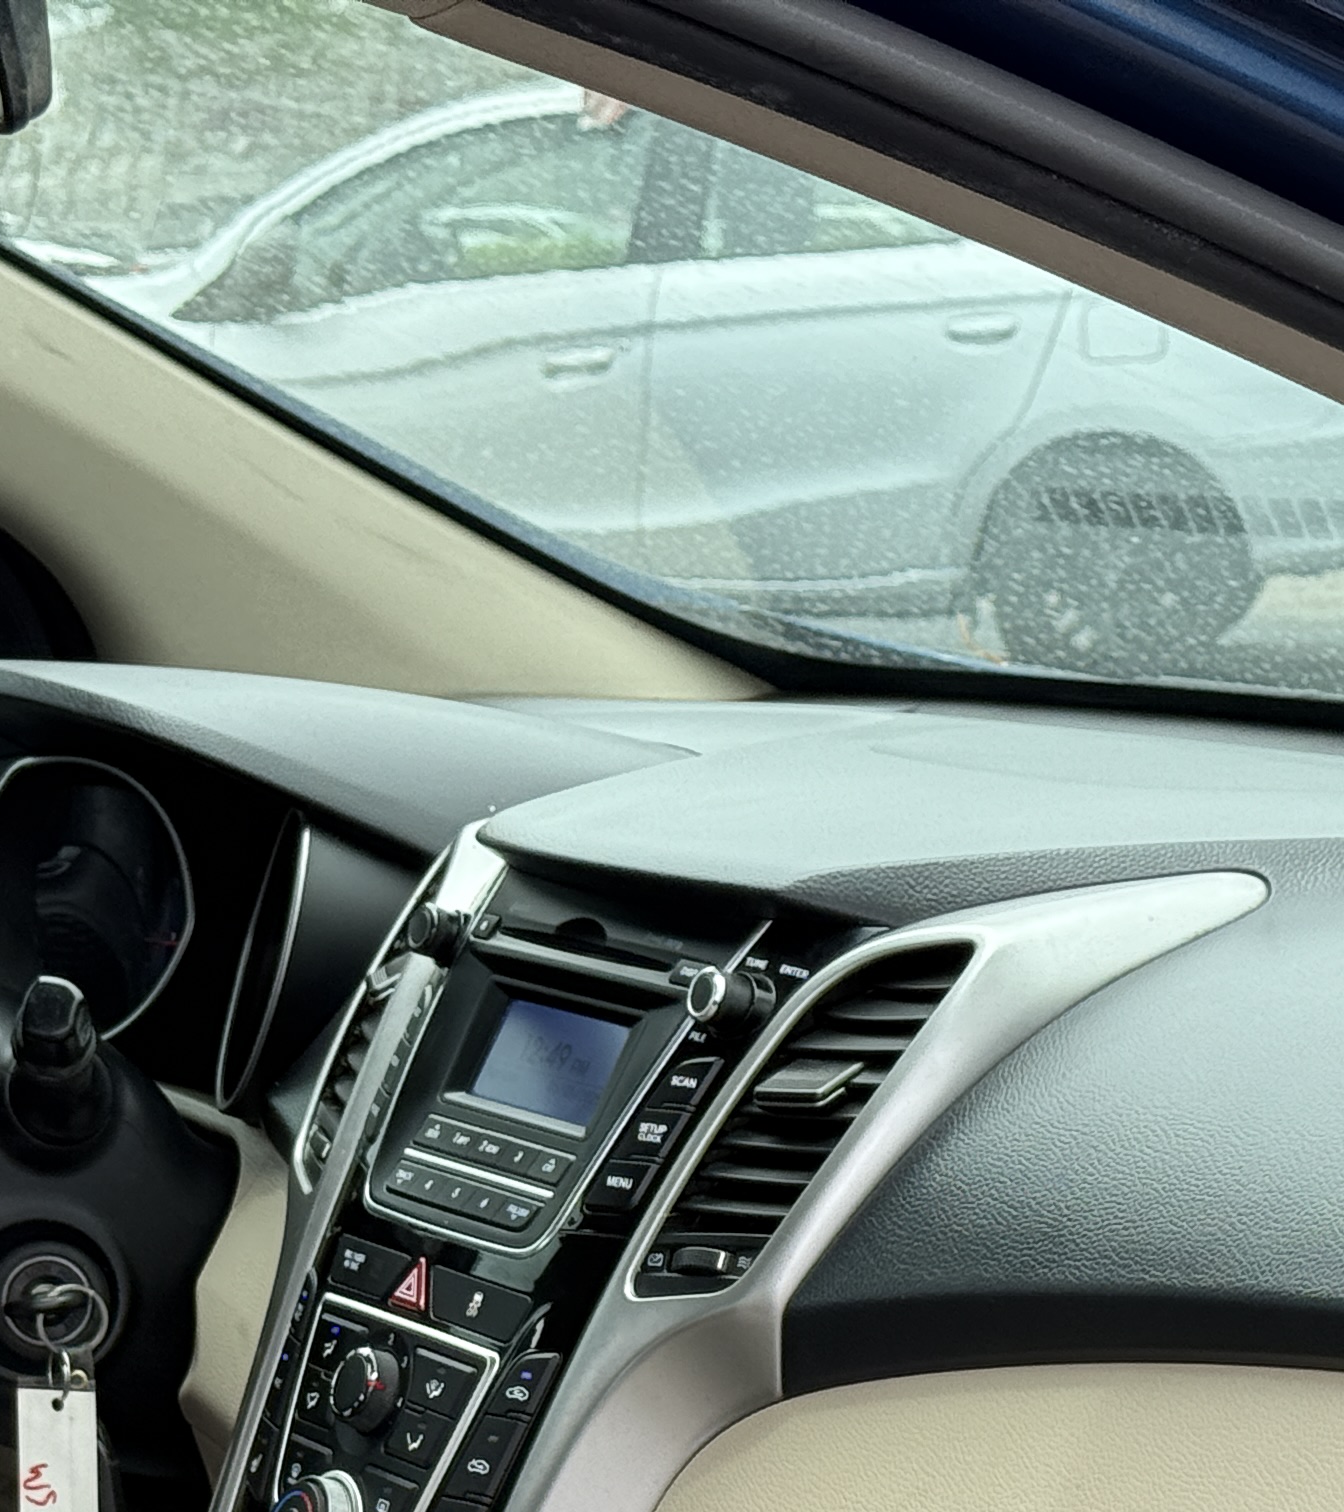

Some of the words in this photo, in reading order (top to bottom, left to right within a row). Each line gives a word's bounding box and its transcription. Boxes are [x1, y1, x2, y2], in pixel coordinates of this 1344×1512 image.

[779, 963, 810, 979] ENTER
[670, 1074, 698, 1089] SCAN
[638, 1122, 668, 1134] SETUP
[637, 1132, 662, 1143] CLOCK
[606, 1174, 633, 1190] MENU
